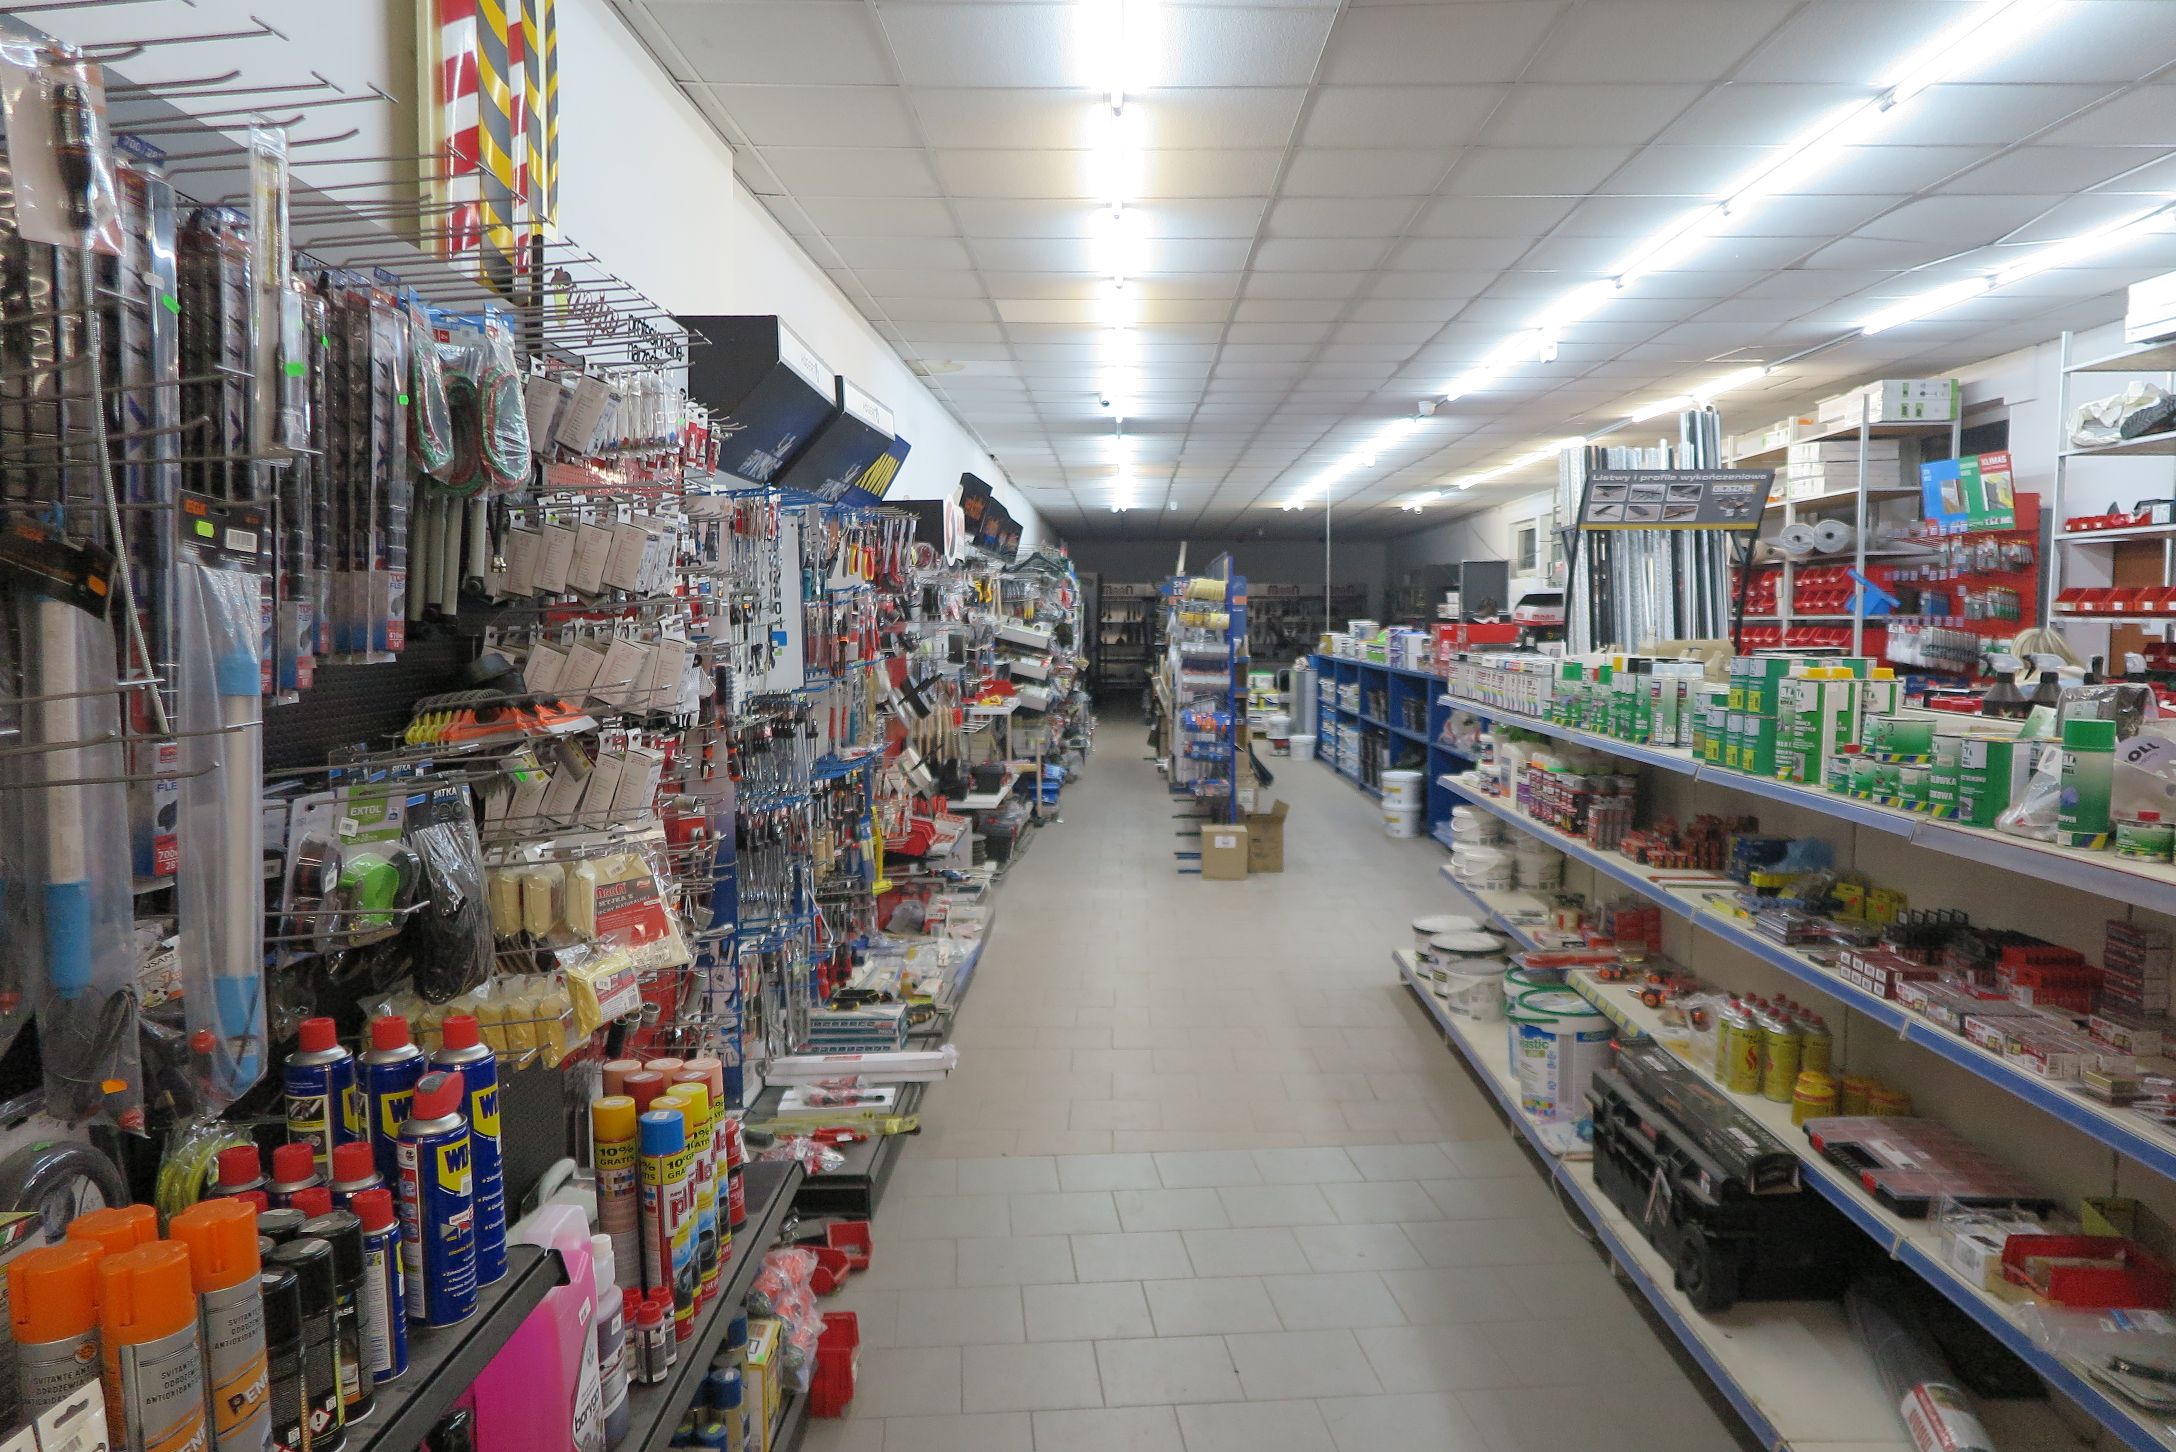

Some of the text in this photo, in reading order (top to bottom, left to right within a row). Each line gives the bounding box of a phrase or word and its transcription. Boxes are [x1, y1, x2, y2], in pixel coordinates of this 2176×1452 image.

[1592, 474, 1631, 483] Listwy
[1640, 474, 1677, 483] profile
[1680, 473, 1768, 483] wykończeniowe
[157, 781, 178, 792] FLE
[600, 1146, 635, 1157] 10%
[600, 1154, 635, 1166] GRATIS
